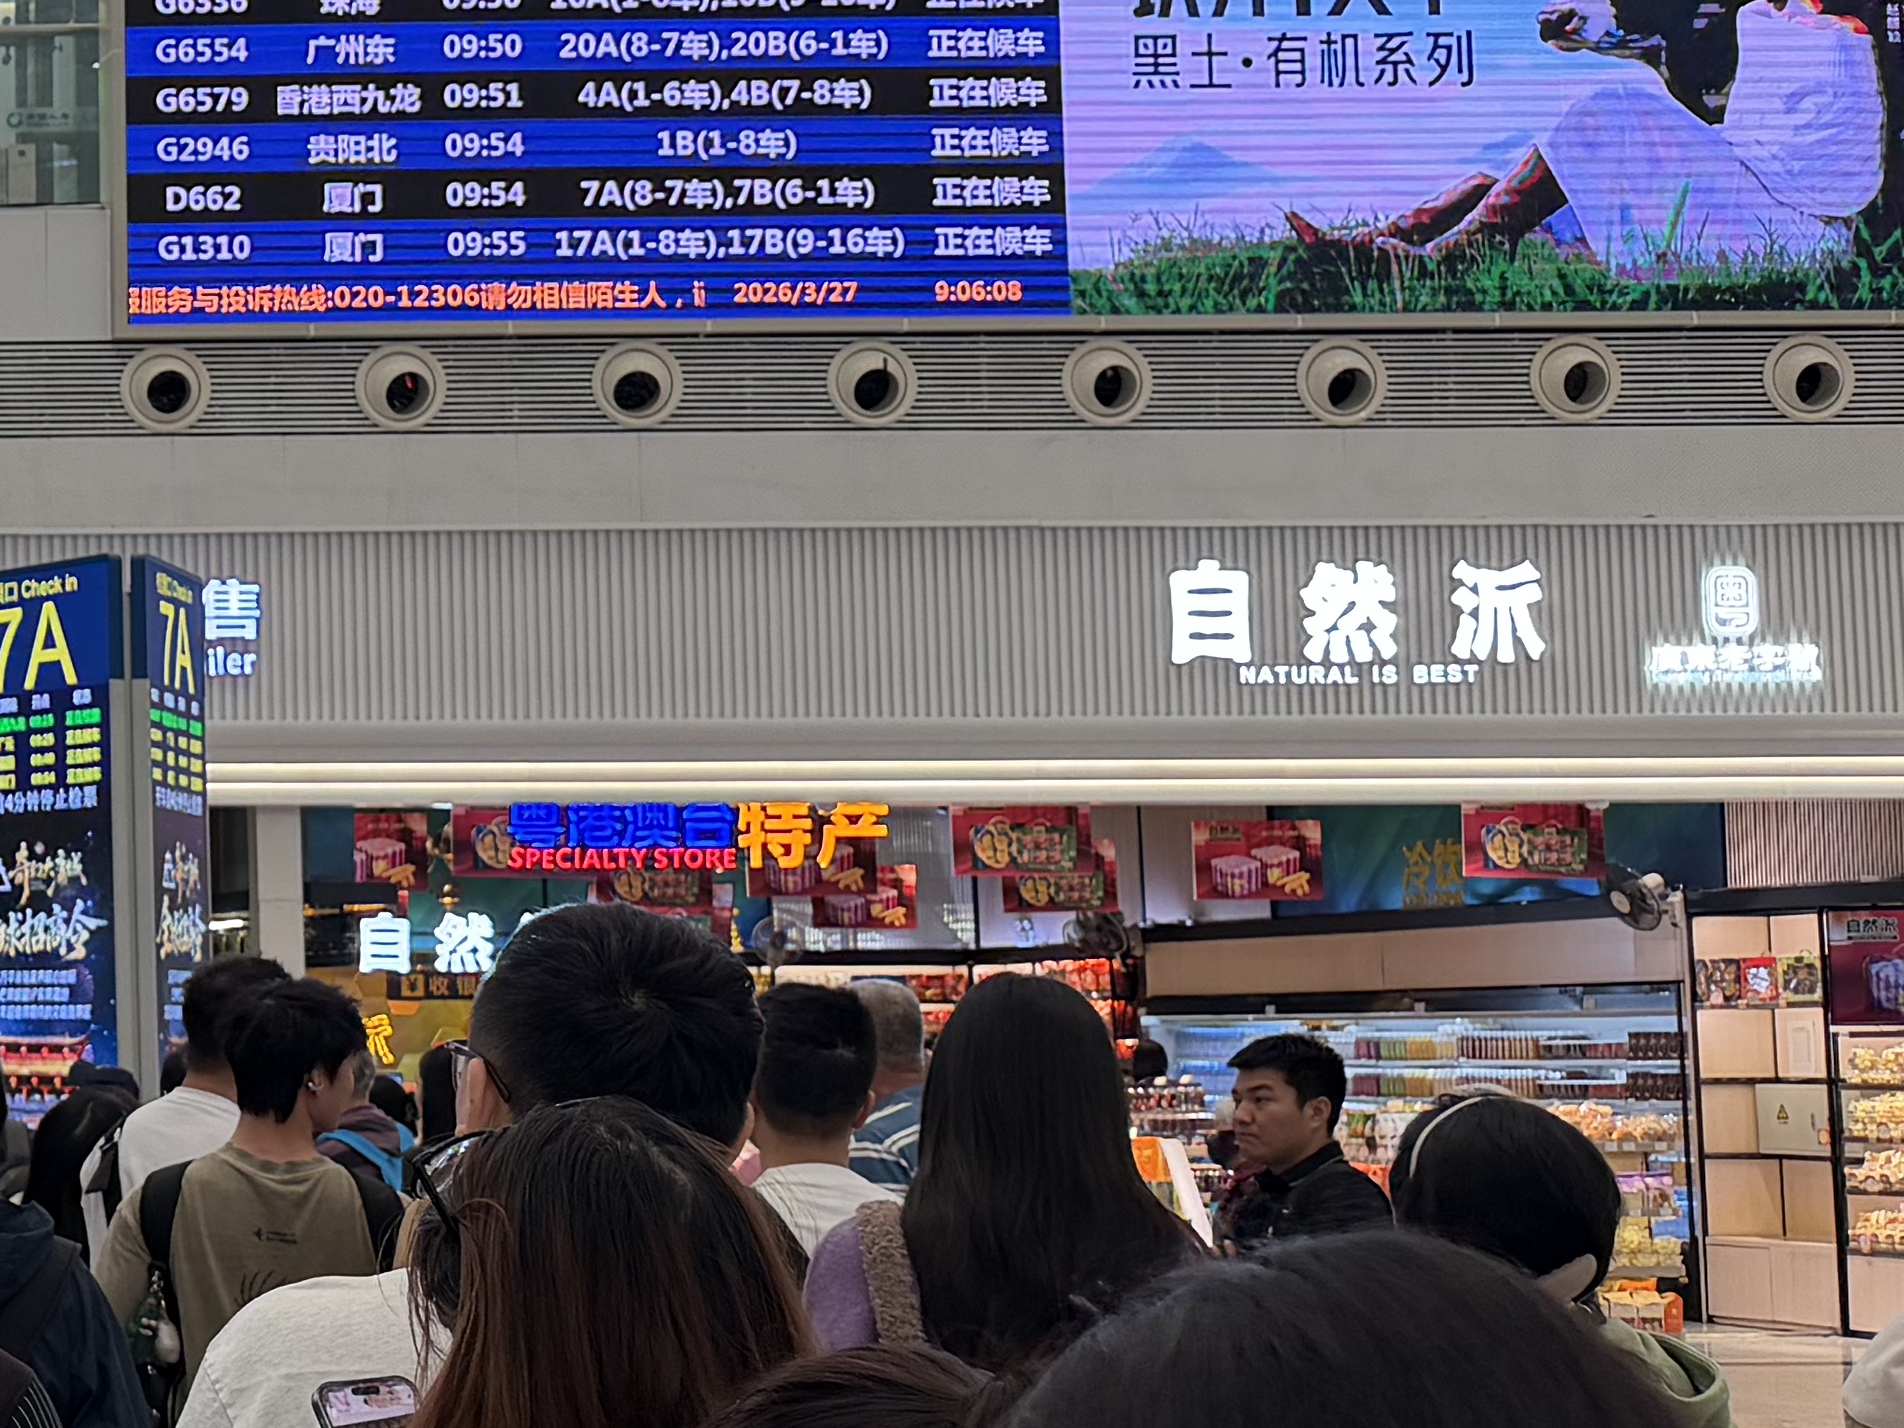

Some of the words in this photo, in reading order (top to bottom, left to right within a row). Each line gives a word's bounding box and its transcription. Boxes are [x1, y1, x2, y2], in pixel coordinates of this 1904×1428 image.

[155, 37, 249, 63] G6554
[306, 34, 395, 65] 广州东
[443, 33, 523, 59] 09:50
[927, 28, 1045, 58] 正在候车
[155, 86, 249, 113] G6579
[276, 82, 422, 116] 香港西九龙
[443, 82, 523, 108] 09:51
[929, 76, 1048, 108] 正在候车
[156, 135, 250, 162] G2946
[307, 133, 398, 165] 贵阳北
[445, 132, 525, 158] 09:54
[657, 128, 797, 161] 1B(1-8车)
[930, 126, 1050, 157] 正在候车
[165, 185, 241, 211] D662
[322, 182, 383, 214] 厦门
[445, 181, 526, 207] 09:54
[932, 175, 1051, 207] 正在候车
[158, 234, 251, 261] G1310
[323, 231, 384, 263] 厦门
[447, 230, 526, 257] 09:55
[934, 225, 1053, 256] 正在候车
[733, 281, 858, 306] 2026/3/27
[934, 280, 1023, 302] 9:06:08
[21, 575, 63, 599] Check
[65, 573, 78, 592] in
[202, 578, 260, 640] 售
[1169, 559, 1546, 664] 自然派
[159, 600, 195, 695] 7A
[1239, 664, 1359, 685] NATURAL
[1372, 664, 1398, 684] IS
[1413, 663, 1480, 683] BEST
[508, 846, 648, 871] SPECIALTY
[654, 847, 736, 872] STORE
